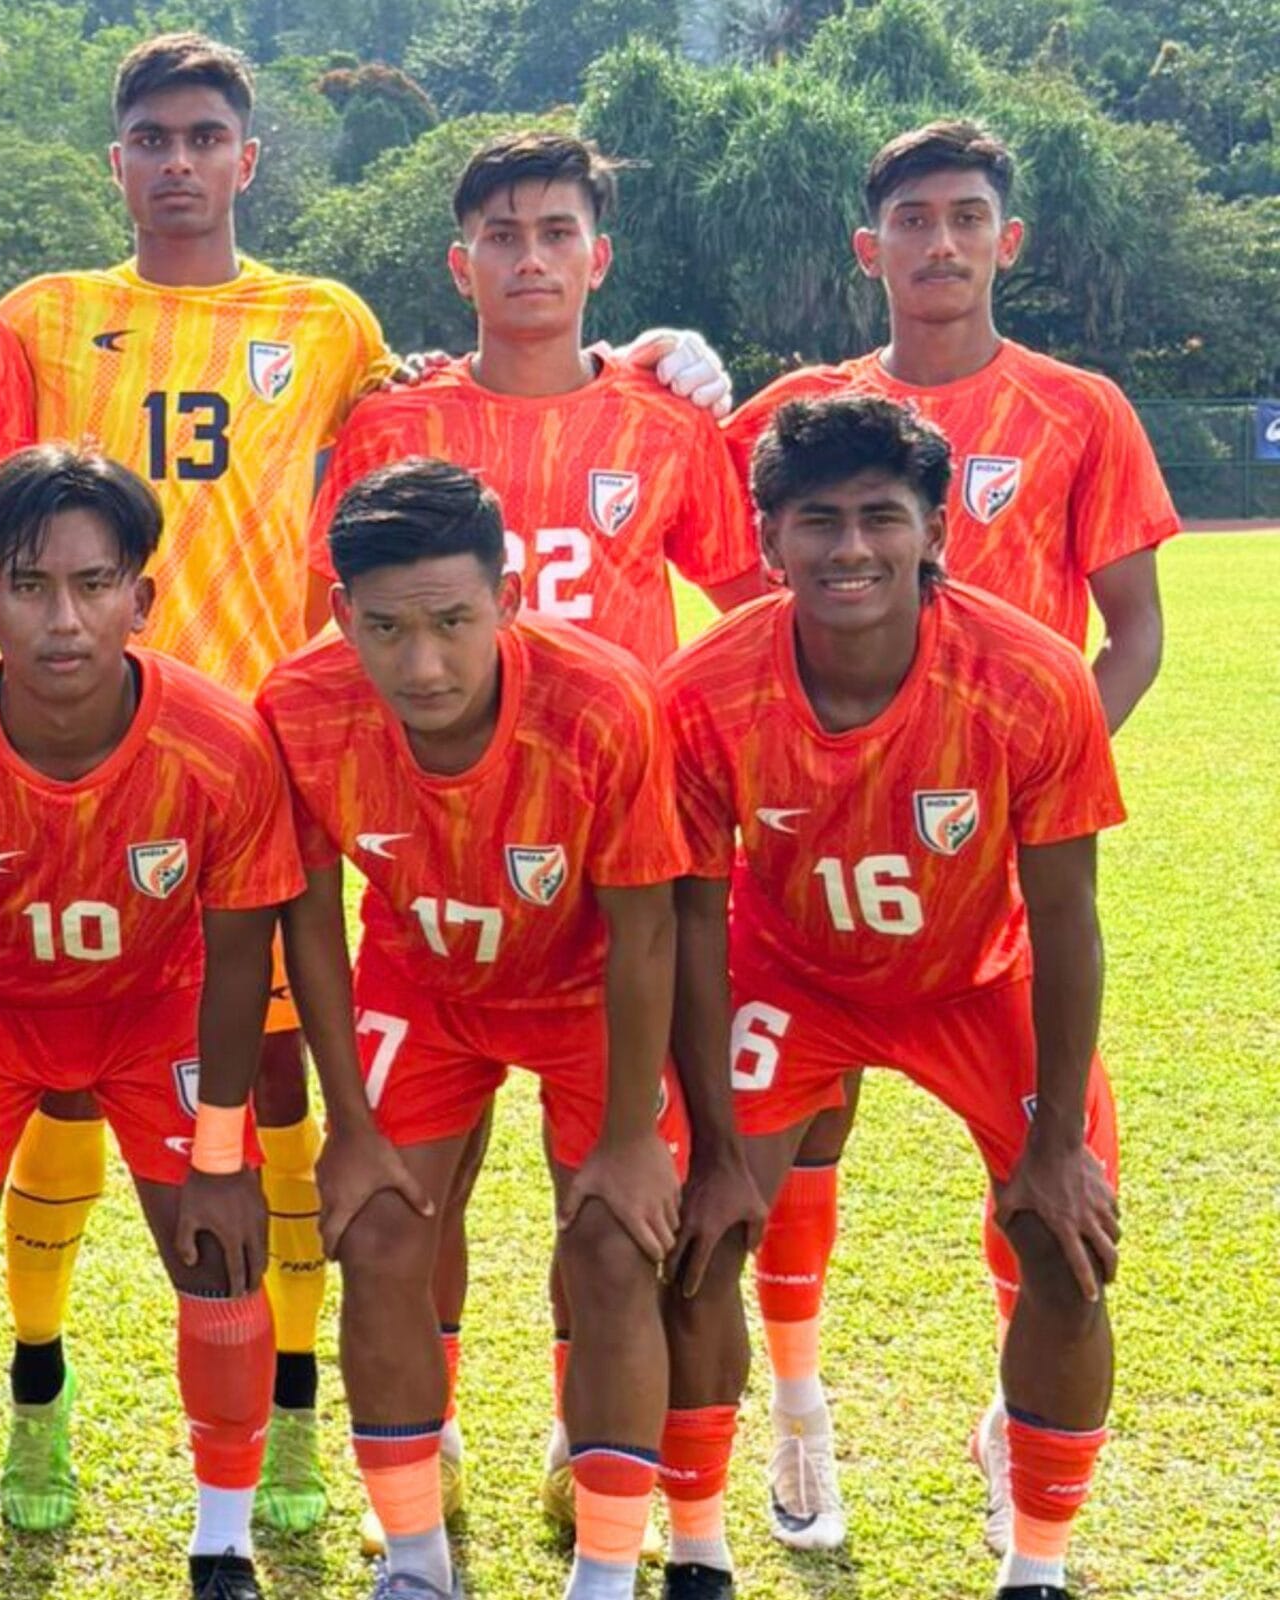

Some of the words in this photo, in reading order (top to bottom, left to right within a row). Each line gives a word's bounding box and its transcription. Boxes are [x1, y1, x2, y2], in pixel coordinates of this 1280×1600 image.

[142, 391, 230, 481] 13
[22, 900, 121, 961] 10
[410, 896, 504, 963] 17
[813, 854, 924, 936] 16
[354, 1005, 410, 1109] 7
[731, 1001, 791, 1090] 6
